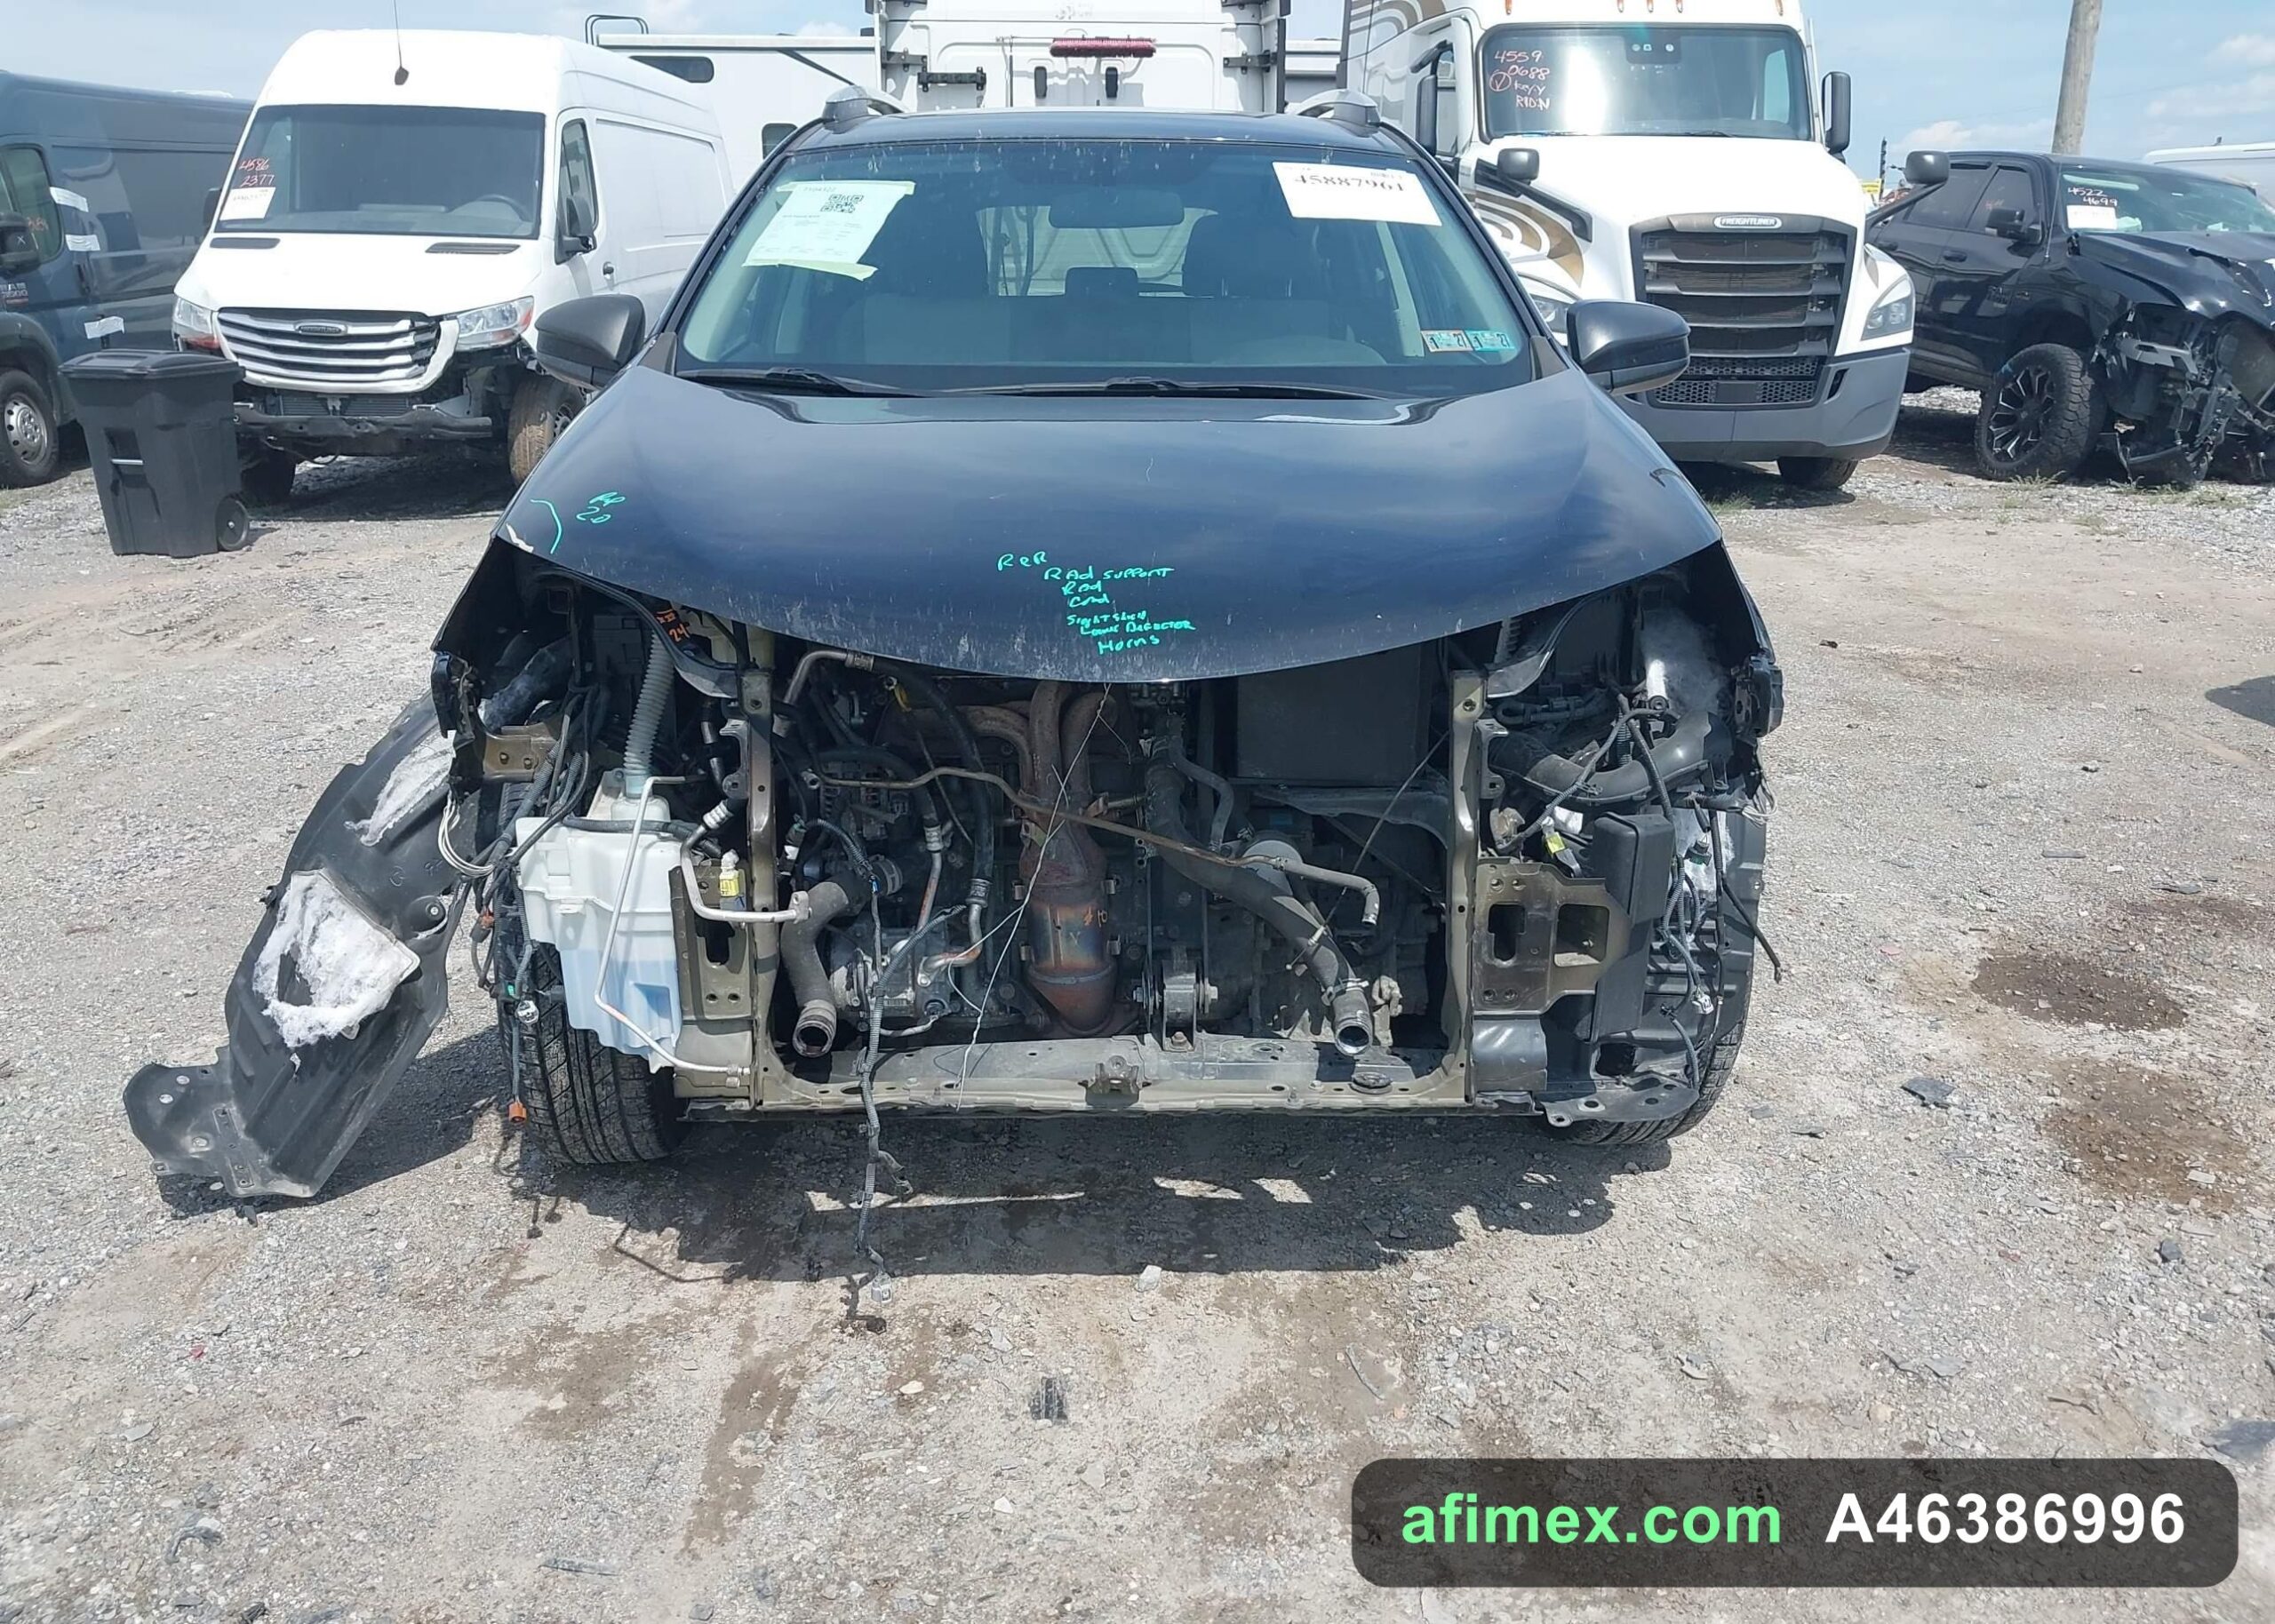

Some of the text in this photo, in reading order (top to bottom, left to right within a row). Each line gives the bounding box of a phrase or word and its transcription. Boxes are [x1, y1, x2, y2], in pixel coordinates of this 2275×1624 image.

[1494, 50, 1543, 64] 4559
[1507, 64, 1551, 81] 0688
[238, 157, 270, 171] 4586
[240, 173, 275, 187] 2377
[2067, 187, 2108, 196] 4522
[2082, 196, 2118, 207] 4699
[1720, 216, 1776, 226] FREIGHTLINER
[1098, 634, 1161, 655] Horns
